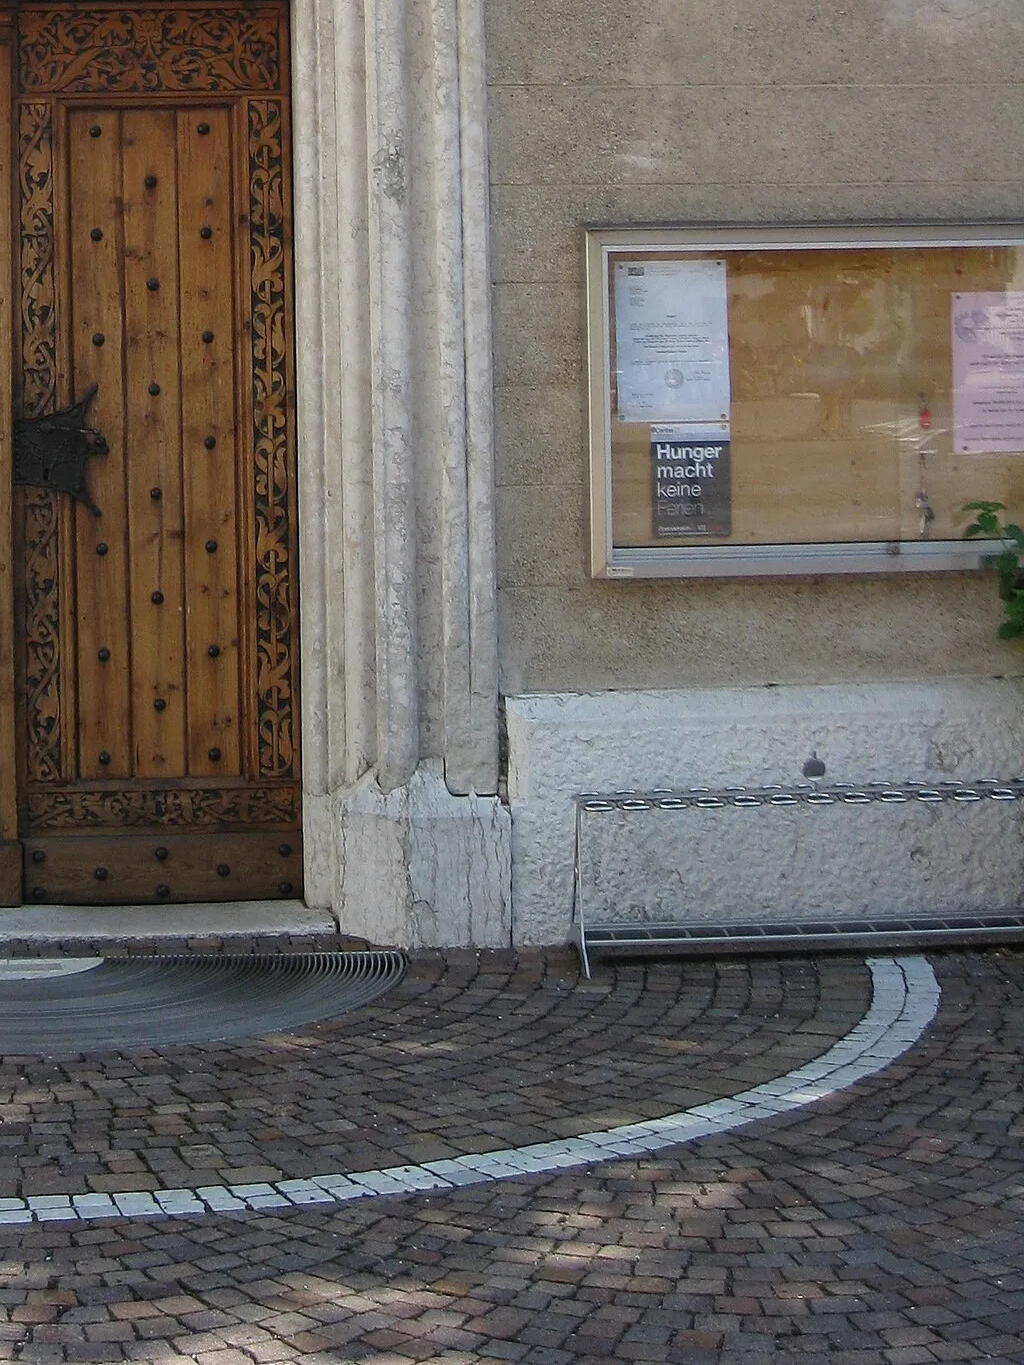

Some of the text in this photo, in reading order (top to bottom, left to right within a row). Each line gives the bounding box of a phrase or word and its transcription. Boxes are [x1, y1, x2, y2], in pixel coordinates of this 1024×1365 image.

[656, 443, 723, 462] Hunger
[657, 462, 714, 479] macht
[657, 481, 702, 498] keine
